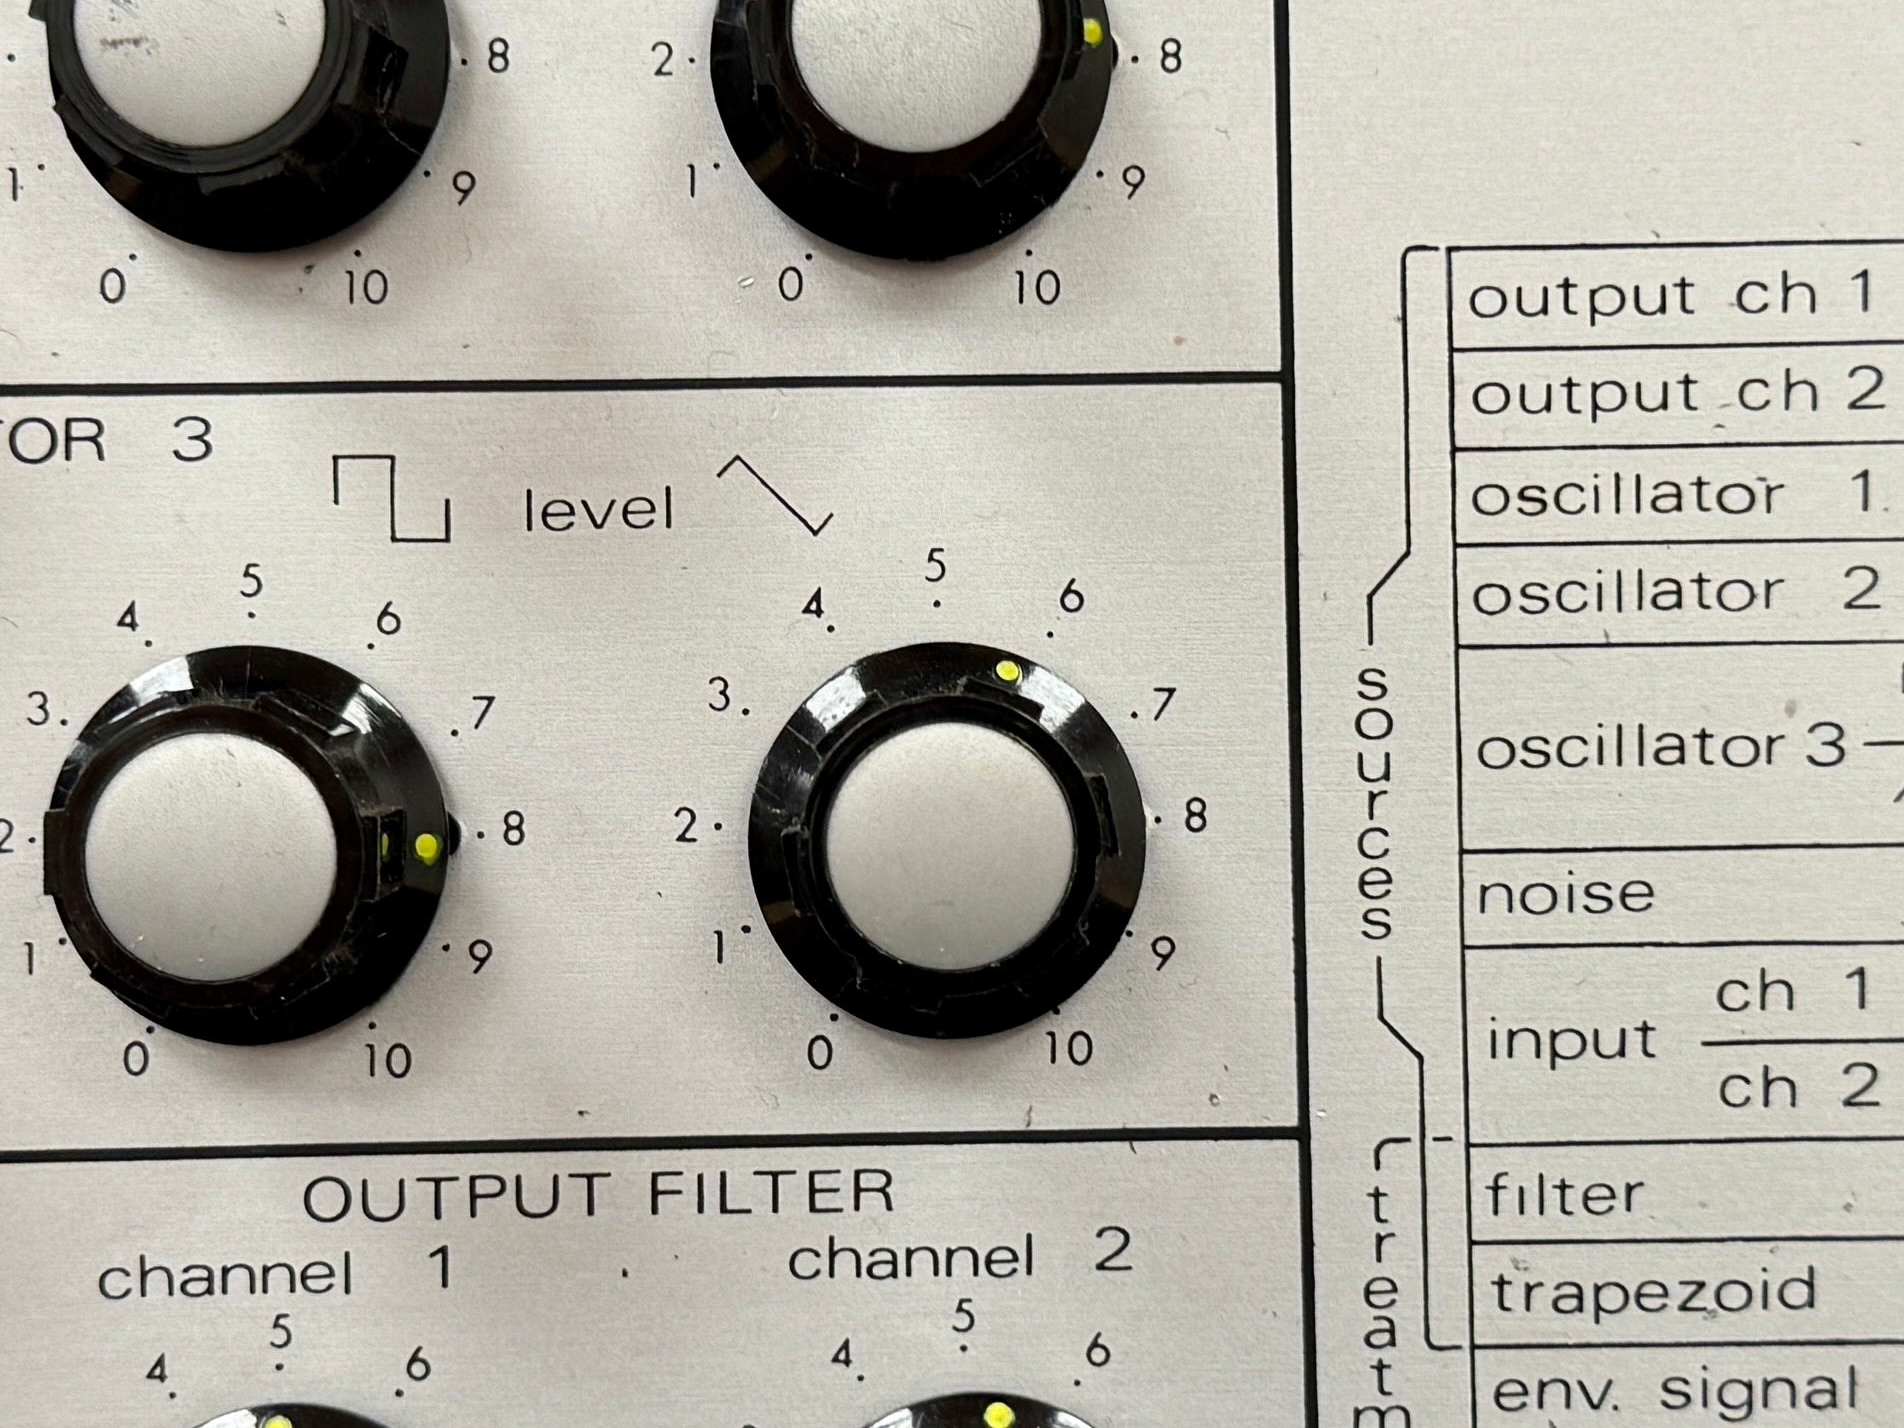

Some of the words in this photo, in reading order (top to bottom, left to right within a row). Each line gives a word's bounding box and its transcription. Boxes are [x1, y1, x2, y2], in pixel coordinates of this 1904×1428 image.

[1160, 37, 1182, 74] 8
[1469, 276, 1695, 327] output
[1734, 270, 1817, 315] ch
[1851, 268, 1869, 312] 1
[1472, 373, 1699, 424] output
[1738, 368, 1818, 411] ch
[1847, 365, 1886, 410] 2
[172, 416, 212, 462] 3
[526, 485, 672, 532] level
[1472, 472, 1785, 517] oscillator
[1852, 469, 1870, 512] 1
[1473, 568, 1785, 616] oscillator
[1844, 565, 1882, 609] 2
[377, 601, 401, 635] 6
[1477, 723, 1786, 770] oscillator
[1806, 721, 1846, 767] 3
[1480, 870, 1655, 915] noise
[1716, 967, 1794, 1012] ch
[1846, 966, 1866, 1010] 1
[1046, 1030, 1093, 1066] 10
[1490, 1020, 1656, 1071] input
[1720, 1064, 1797, 1108] ch
[1842, 1062, 1881, 1109] 2
[304, 1172, 611, 1223] OUTPUT
[651, 1168, 893, 1215] FILTER
[1485, 1172, 1645, 1216] filter
[98, 1251, 351, 1300] channel
[429, 1245, 448, 1289] 1
[789, 1232, 1032, 1281] channel
[1095, 1226, 1133, 1271] 2
[1490, 1265, 1815, 1325] trapezoid
[1493, 1378, 1620, 1412] env.
[1660, 1364, 1859, 1423] signal
